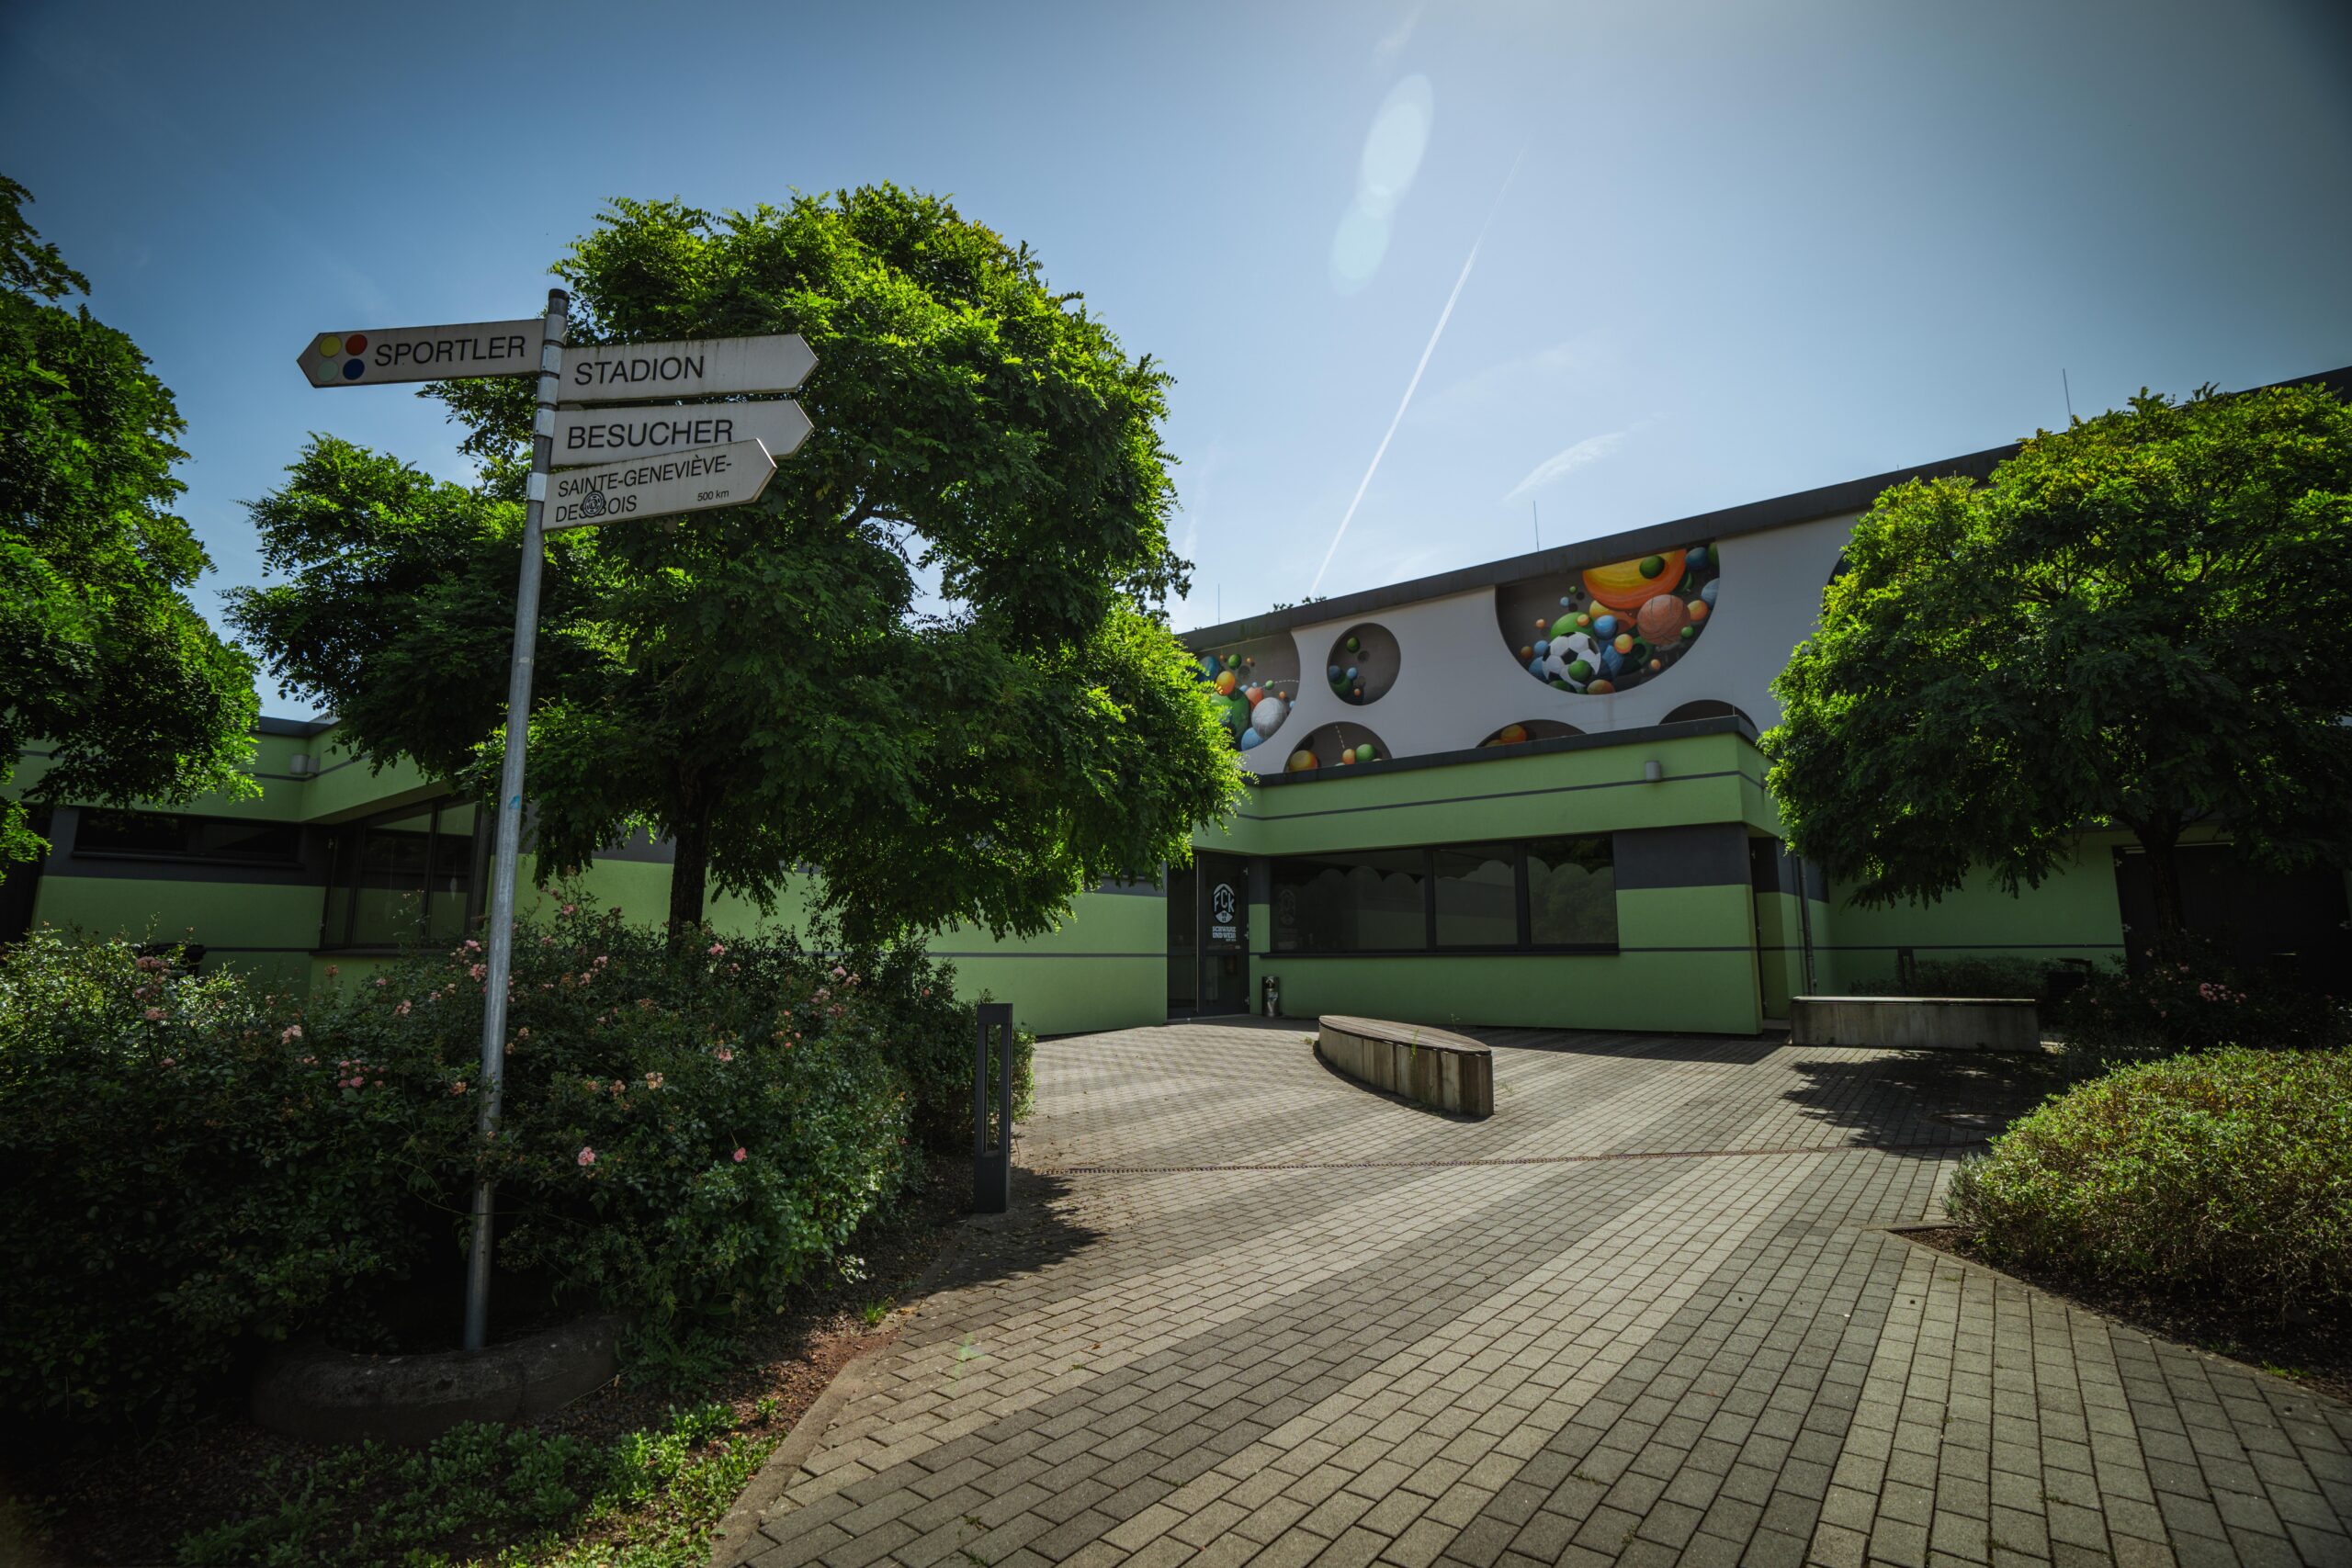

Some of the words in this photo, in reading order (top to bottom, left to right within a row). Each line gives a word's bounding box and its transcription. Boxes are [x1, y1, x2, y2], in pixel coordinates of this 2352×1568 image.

[375, 335, 526, 367] SPORTLER
[574, 355, 705, 386] STADION
[568, 419, 733, 449] BESUCHER
[558, 455, 732, 498] SAINTE-GENEVIÈVE-
[697, 491, 714, 502] 500
[716, 490, 729, 500] km
[1214, 889, 1235, 912] FCK
